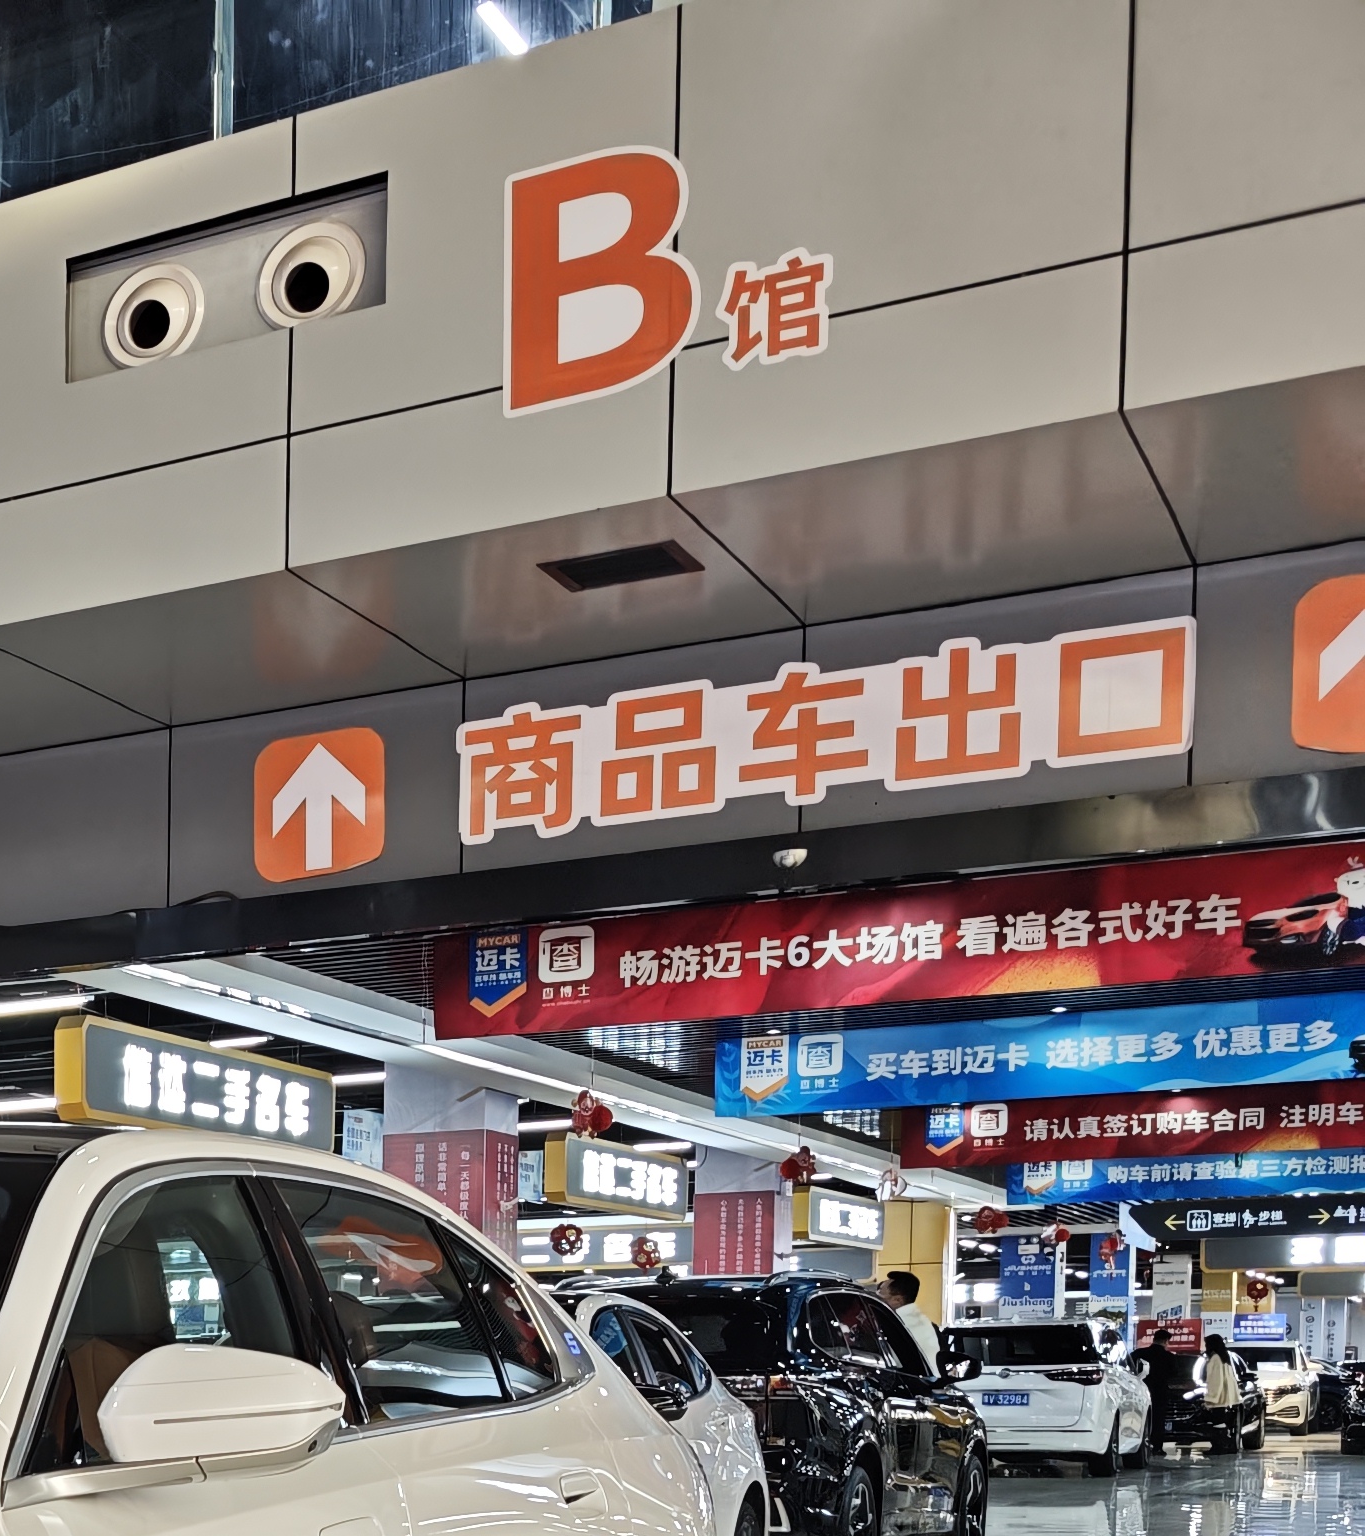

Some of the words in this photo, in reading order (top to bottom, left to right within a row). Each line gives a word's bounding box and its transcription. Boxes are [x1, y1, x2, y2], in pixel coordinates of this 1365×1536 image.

[459, 618, 1194, 842] 商品车出口
[477, 934, 520, 947] MYCAR
[619, 920, 943, 988] 畅游迈卡6大场馆
[956, 894, 1241, 957] 看遍各式好车
[476, 947, 521, 972] 迈卡
[747, 1040, 783, 1049] MYCAR
[866, 1043, 1029, 1082] 买车到迈卡
[1046, 1030, 1183, 1069] 选择更多
[1193, 1020, 1338, 1059] 优惠更多
[747, 1049, 783, 1067] 迈卡
[930, 1115, 960, 1129] 迈卡
[1024, 1107, 1265, 1142] 请认真签订购车合同
